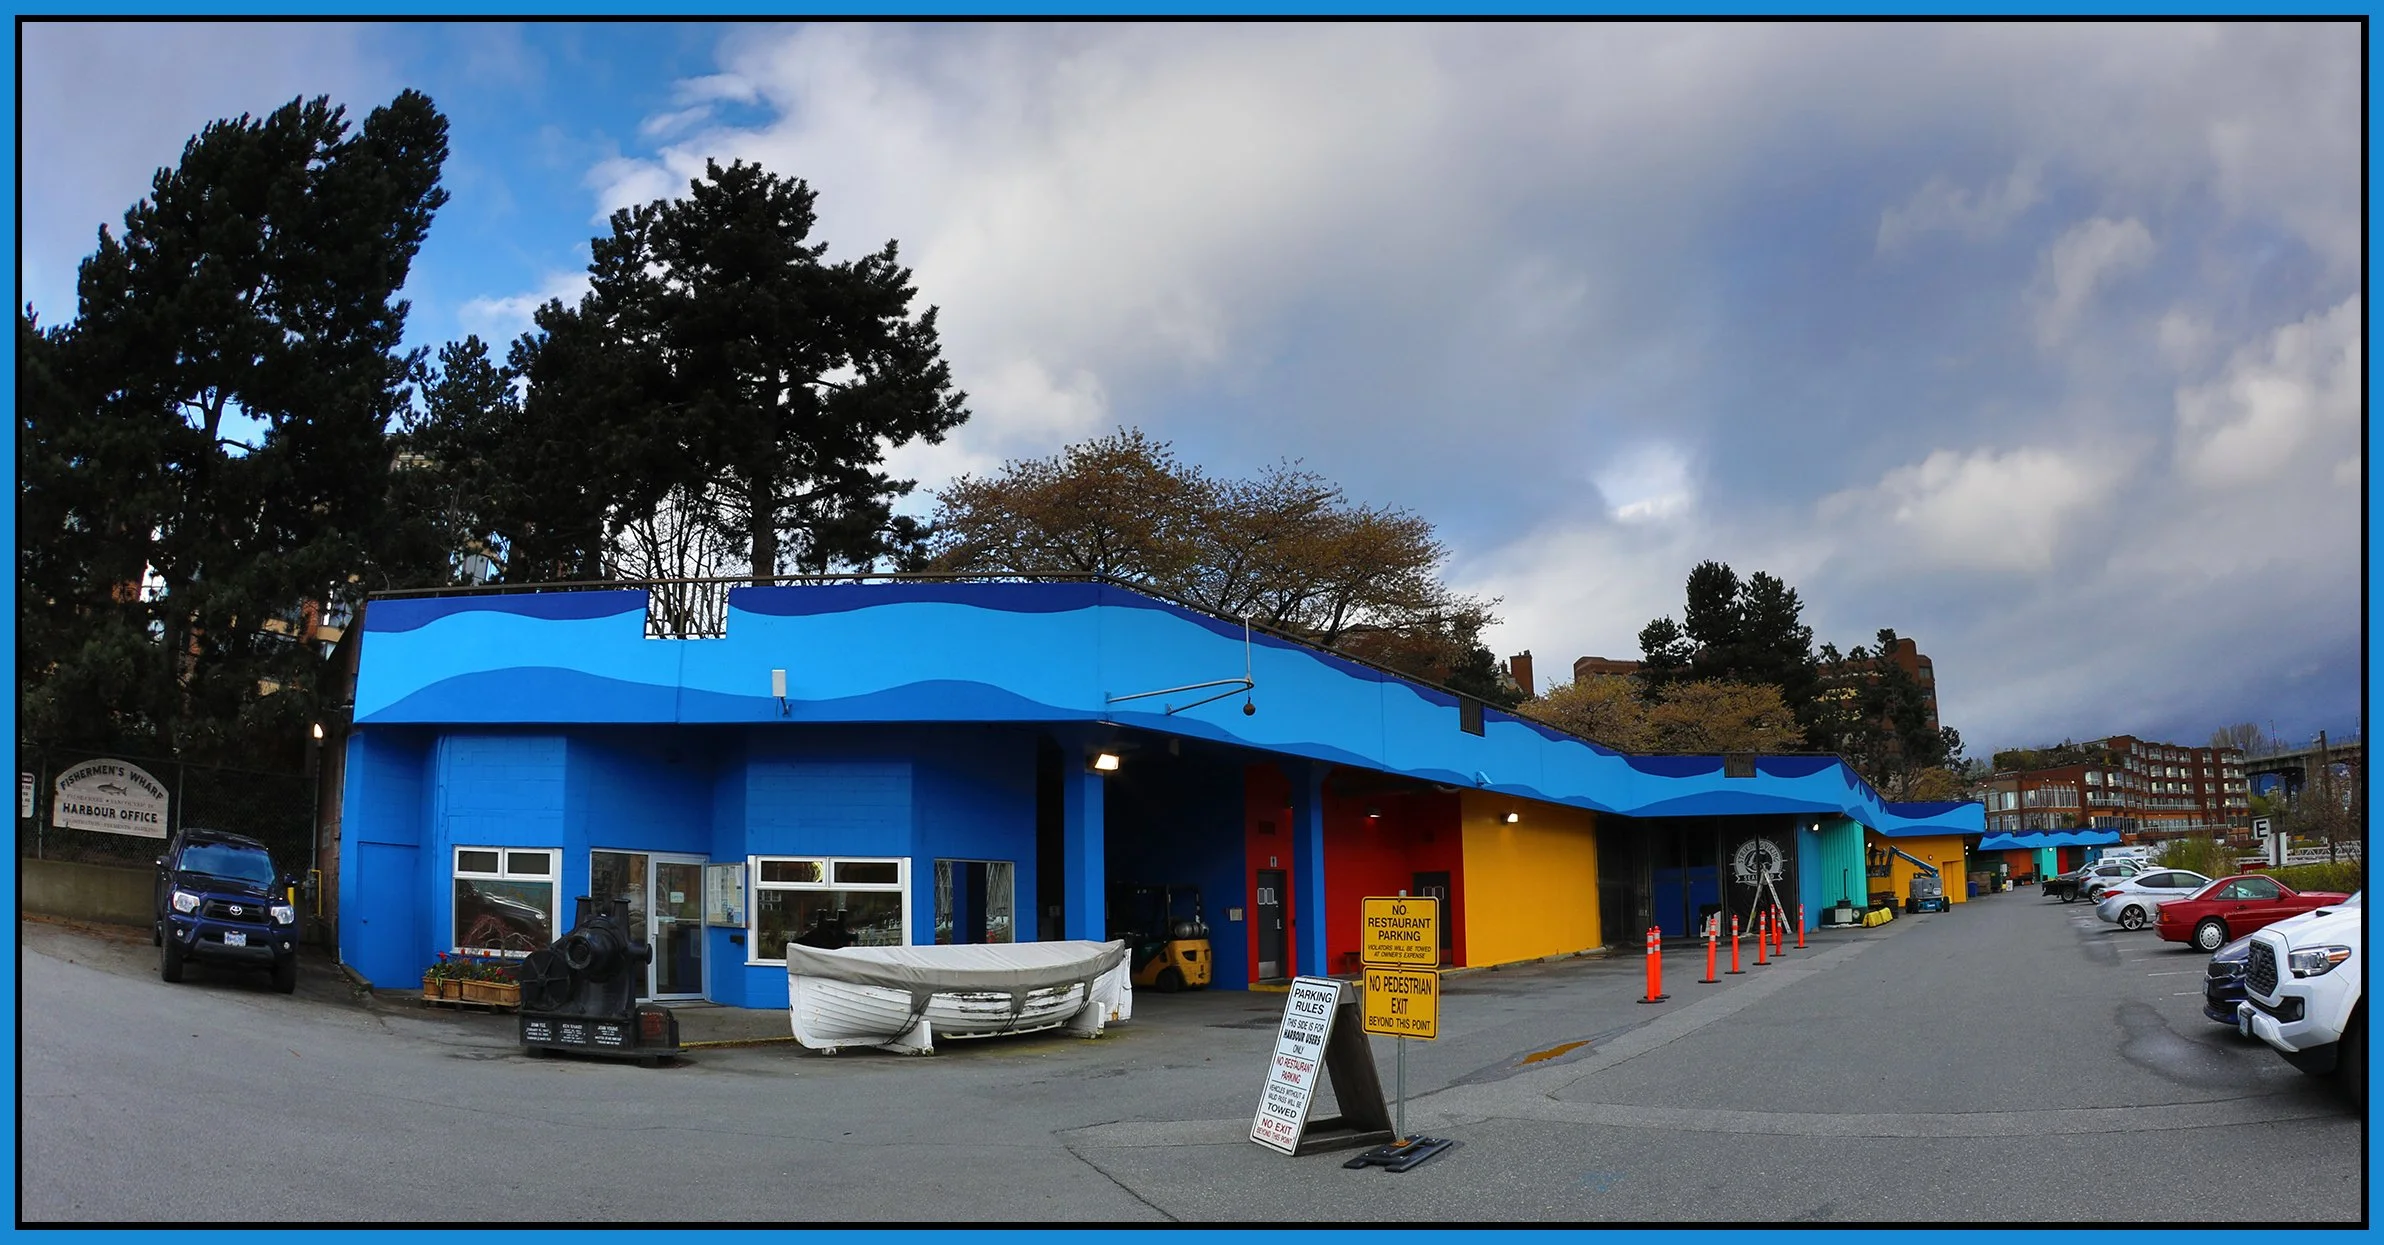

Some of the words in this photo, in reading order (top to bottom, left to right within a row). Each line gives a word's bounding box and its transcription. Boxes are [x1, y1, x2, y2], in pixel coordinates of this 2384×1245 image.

[60, 765, 124, 790] FISHERMEN'S
[130, 771, 164, 800] WHARF
[63, 803, 116, 819] HARBOUR
[120, 810, 158, 824] OFFICE
[2256, 820, 2268, 838] E
[1392, 905, 1406, 915] NO
[1368, 918, 1431, 928] RESTAURANT
[1379, 931, 1420, 941] PARKING
[1370, 975, 1380, 992] NO
[1384, 976, 1431, 995] PEDESTRIAN
[1294, 988, 1332, 1003] PARKING
[1295, 1001, 1324, 1014] RULES
[1392, 998, 1408, 1014] EXIT
[1287, 1018, 1297, 1028] THIS
[1297, 1020, 1307, 1030] SIDE
[1309, 1022, 1314, 1031] IS
[1314, 1024, 1324, 1033] FOR
[1369, 1016, 1393, 1027] BEYOND
[1396, 1018, 1410, 1029] THIS
[1412, 1020, 1430, 1030] POINT
[1284, 1029, 1305, 1042] HARBOUR
[1306, 1034, 1321, 1046] USERS
[1293, 1045, 1304, 1054] ONLY
[1276, 1056, 1284, 1066] NO
[1285, 1058, 1313, 1073] RESTAURANT
[1281, 1071, 1301, 1084] PARKING
[1268, 1093, 1277, 1101] VALID
[1278, 1095, 1287, 1104] PASS
[1270, 1084, 1286, 1094] VEHICLES
[1286, 1089, 1302, 1098] WITHOUT
[1268, 1102, 1296, 1118] TOWED
[1262, 1118, 1273, 1128] NO
[1275, 1123, 1292, 1135] EXIT
[1256, 1127, 1271, 1137] BEYOND
[1281, 1135, 1292, 1144] POINT
